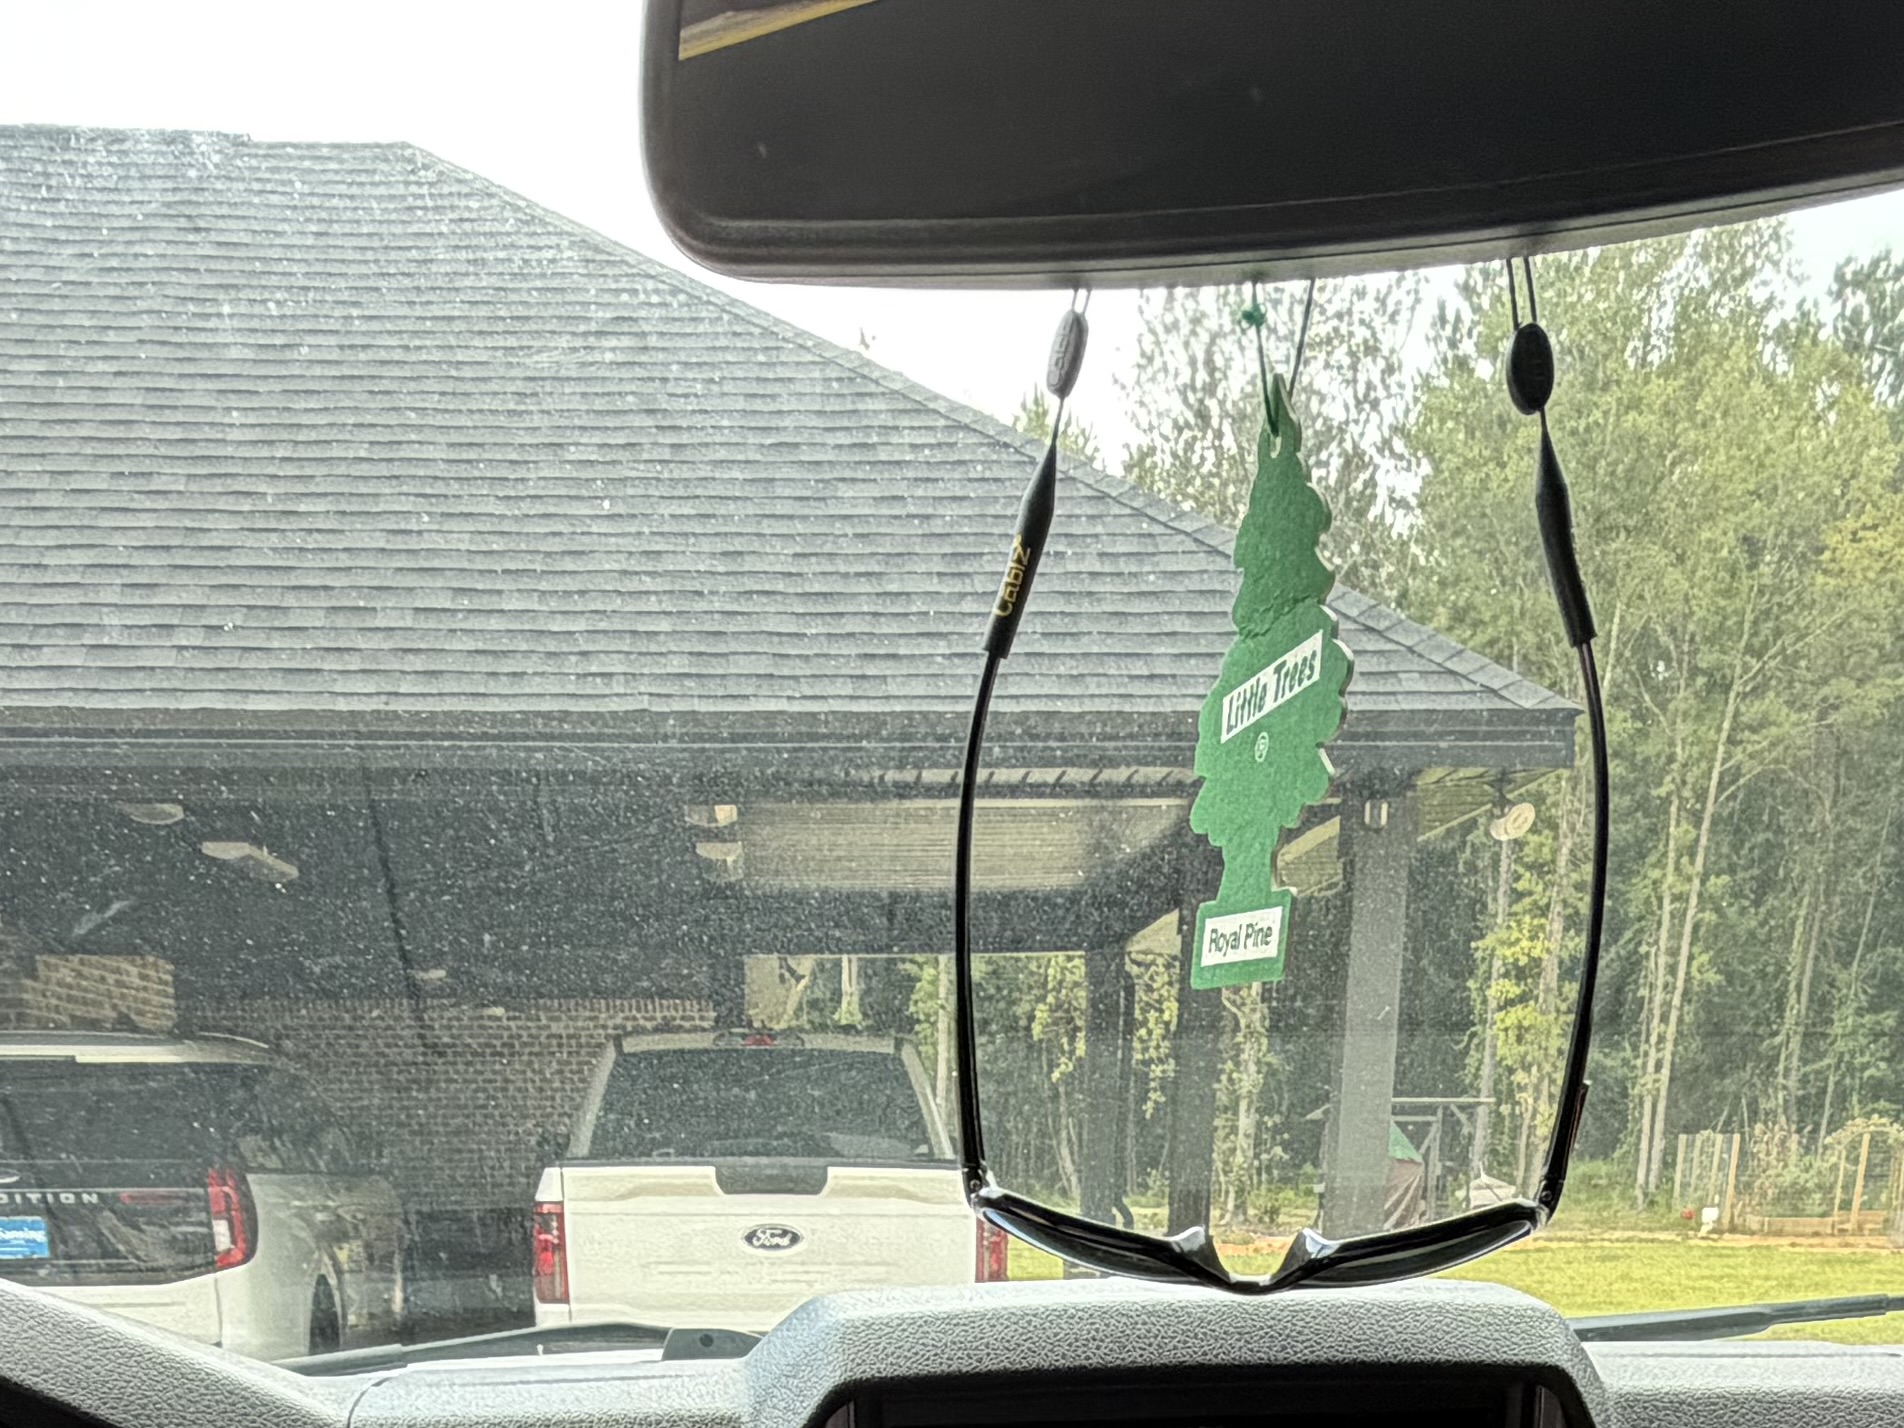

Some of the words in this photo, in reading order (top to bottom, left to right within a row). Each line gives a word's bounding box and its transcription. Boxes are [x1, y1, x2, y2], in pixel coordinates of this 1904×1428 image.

[1226, 675, 1268, 736] Little
[1272, 647, 1319, 704] Trees
[1208, 926, 1242, 955] Royal
[1244, 921, 1274, 951] Pine
[751, 1227, 793, 1250] Ford
